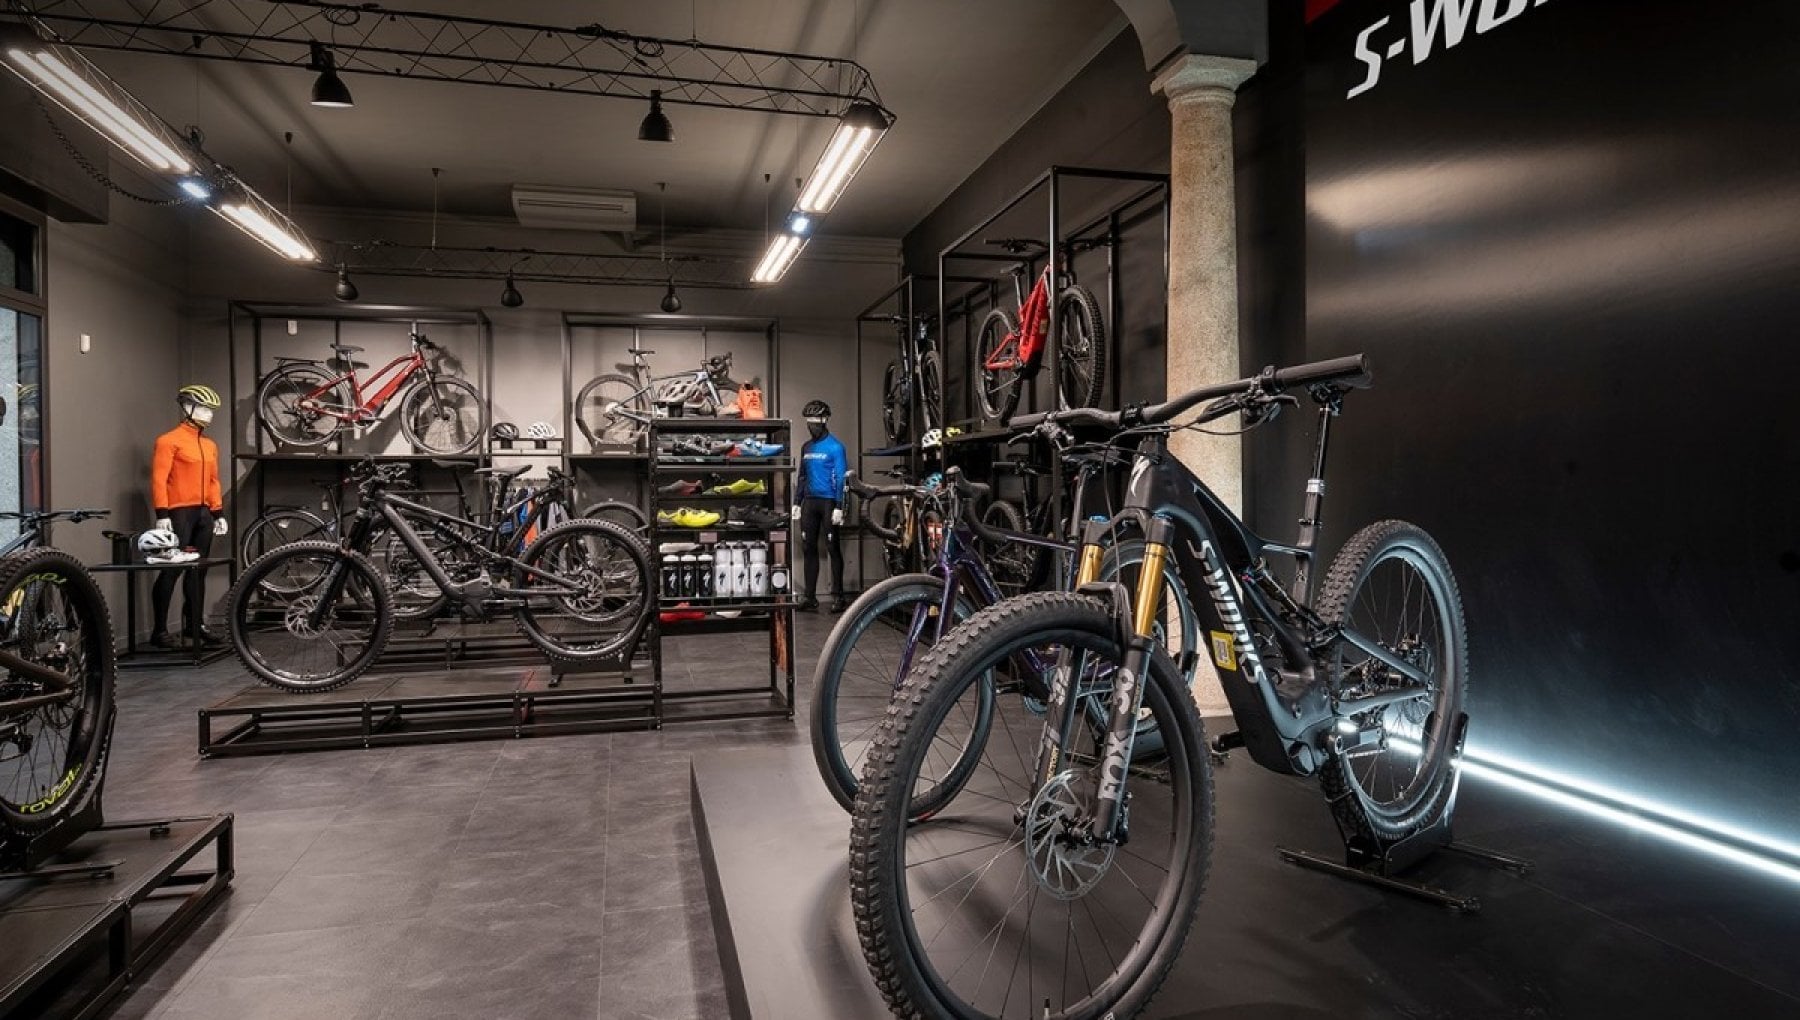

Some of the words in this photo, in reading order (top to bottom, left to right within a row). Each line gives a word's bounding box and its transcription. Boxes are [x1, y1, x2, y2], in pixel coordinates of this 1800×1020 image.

[1346, 0, 1549, 100] S-W
[1187, 539, 1268, 683] S-WORKS
[1047, 743, 1060, 784] ACTORY
[1098, 731, 1132, 799] FOX
